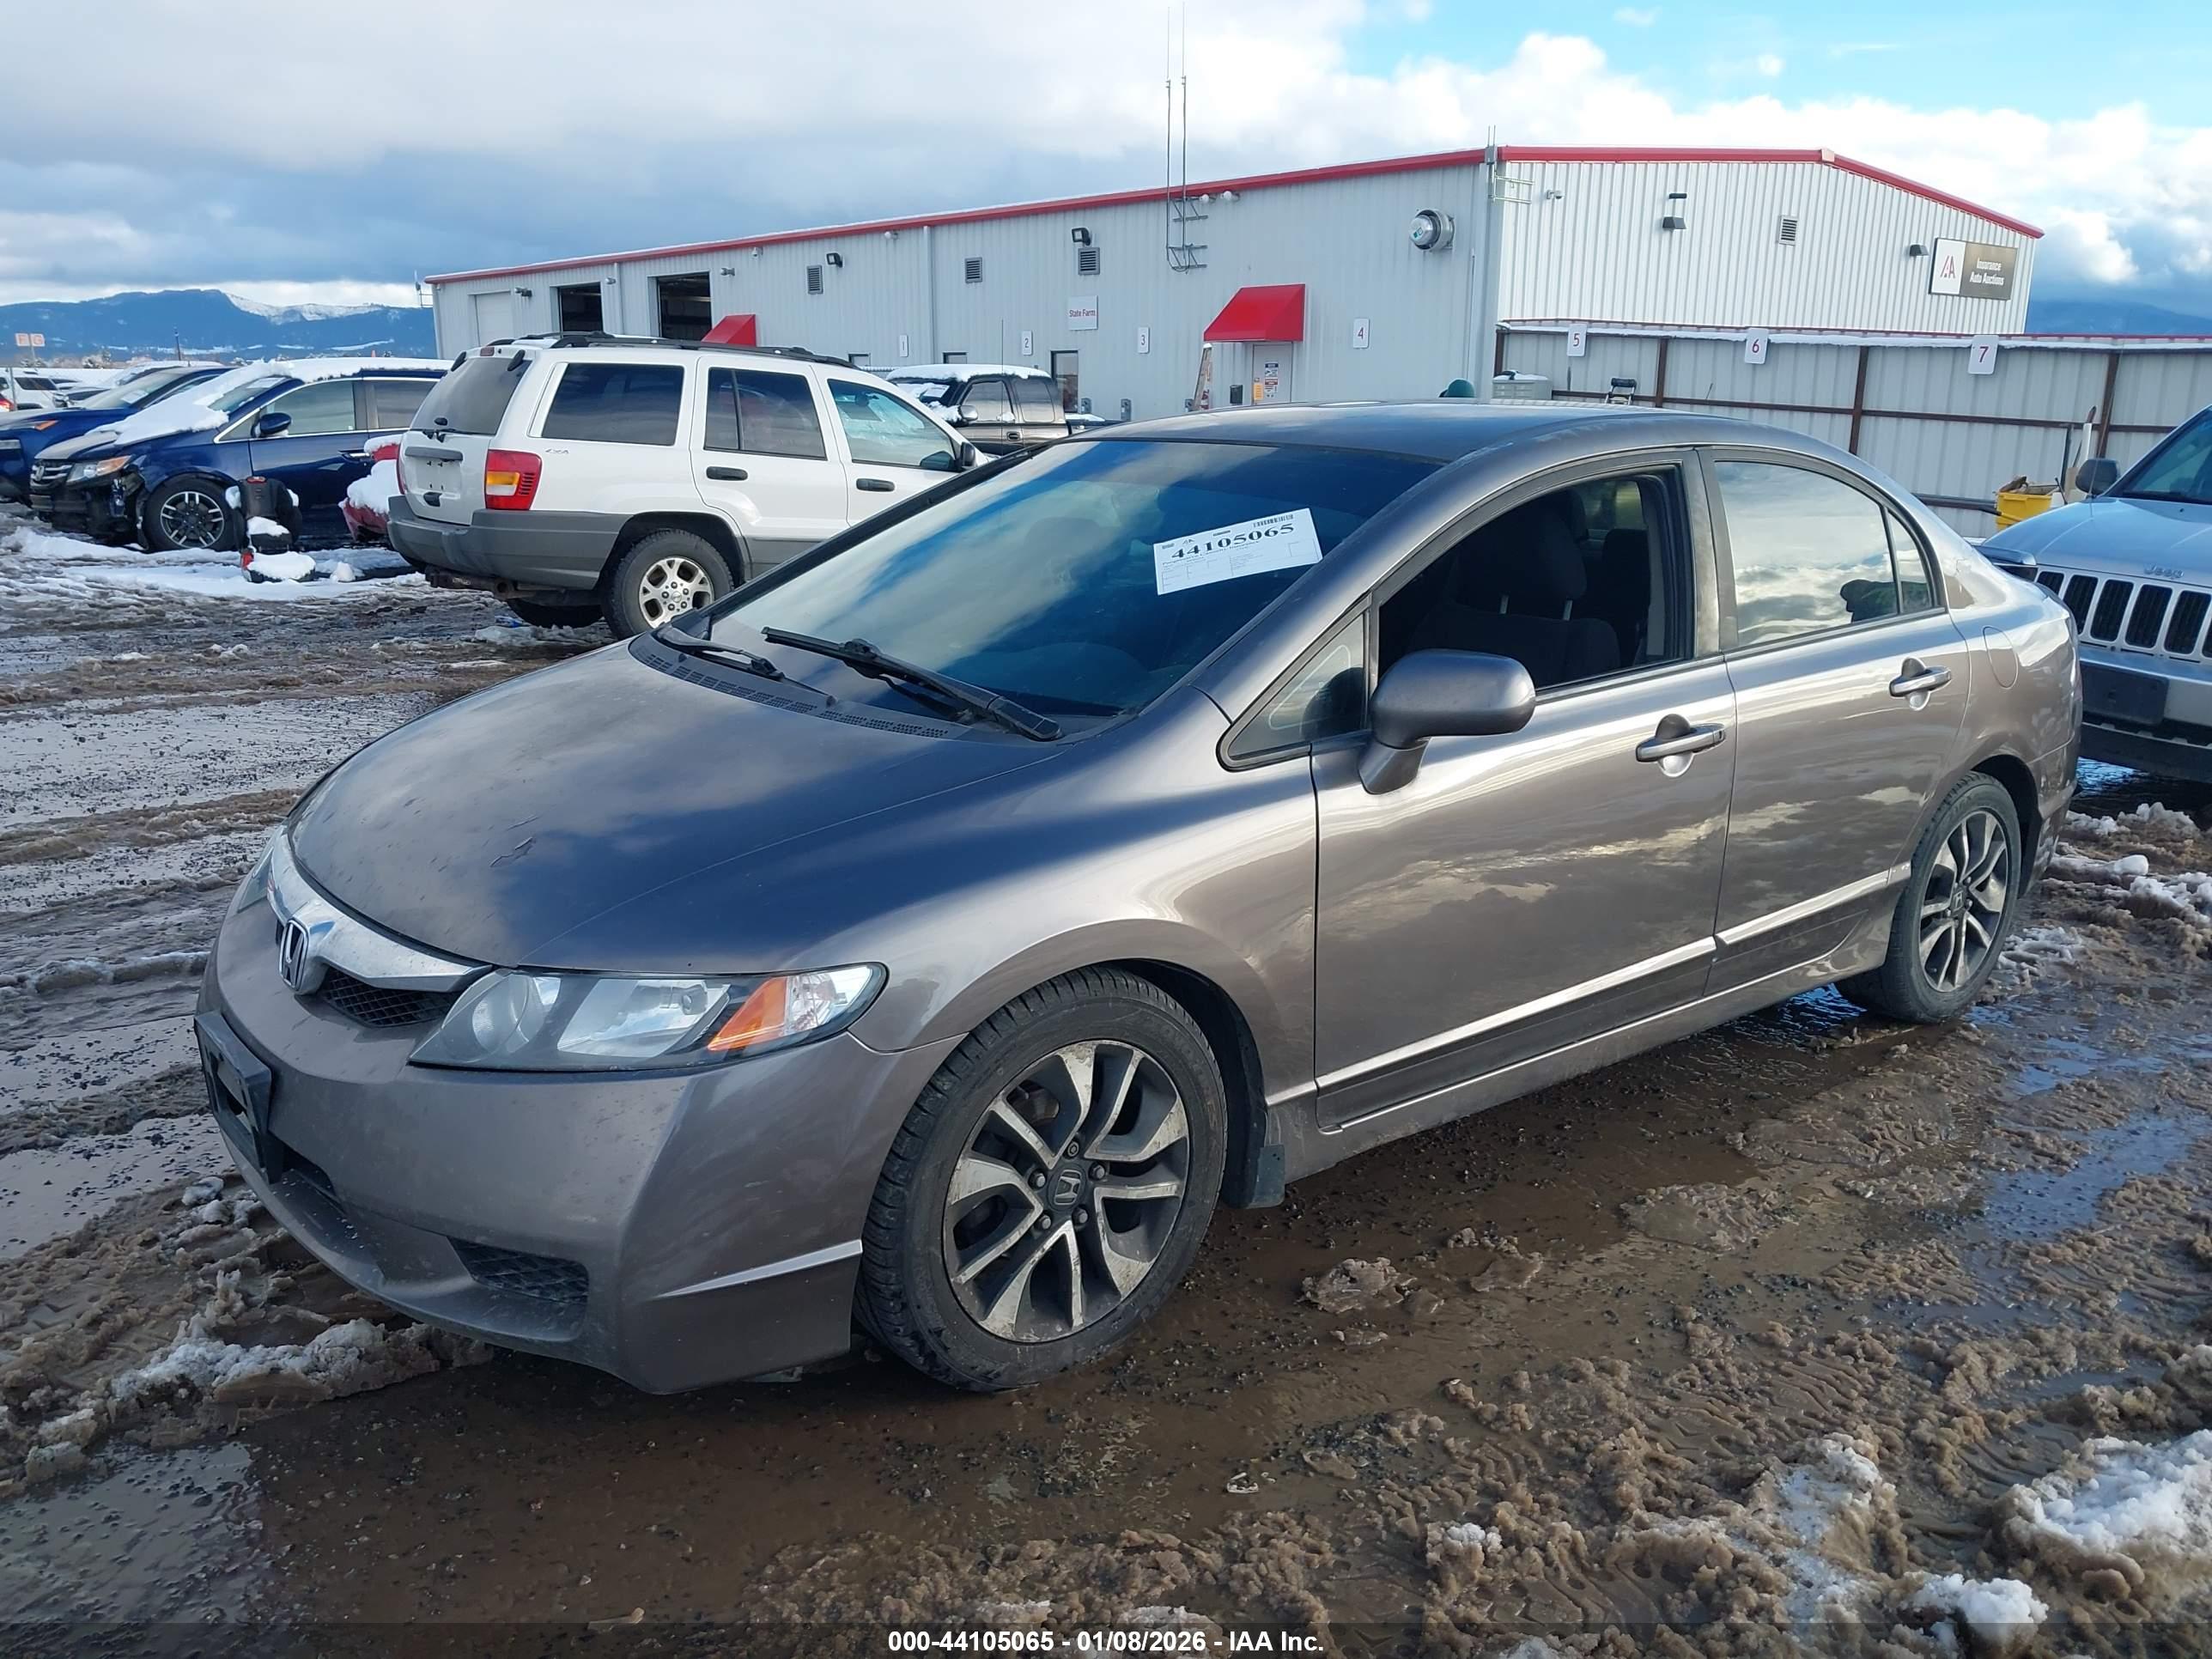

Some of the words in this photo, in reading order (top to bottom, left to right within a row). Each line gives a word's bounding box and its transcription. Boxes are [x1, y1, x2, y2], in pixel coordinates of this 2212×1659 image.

[1969, 271, 1983, 283] Auto
[1069, 309, 1082, 318] State
[1082, 308, 1097, 317] Farm
[1140, 334, 1146, 345] 3
[1357, 326, 1364, 340] 4
[1572, 332, 1580, 347] 5
[1024, 337, 1030, 349] 2
[1752, 338, 1759, 354] 6
[1978, 345, 1990, 363] 7
[1171, 523, 1294, 559] 44105065
[2145, 564, 2184, 579] Jeep
